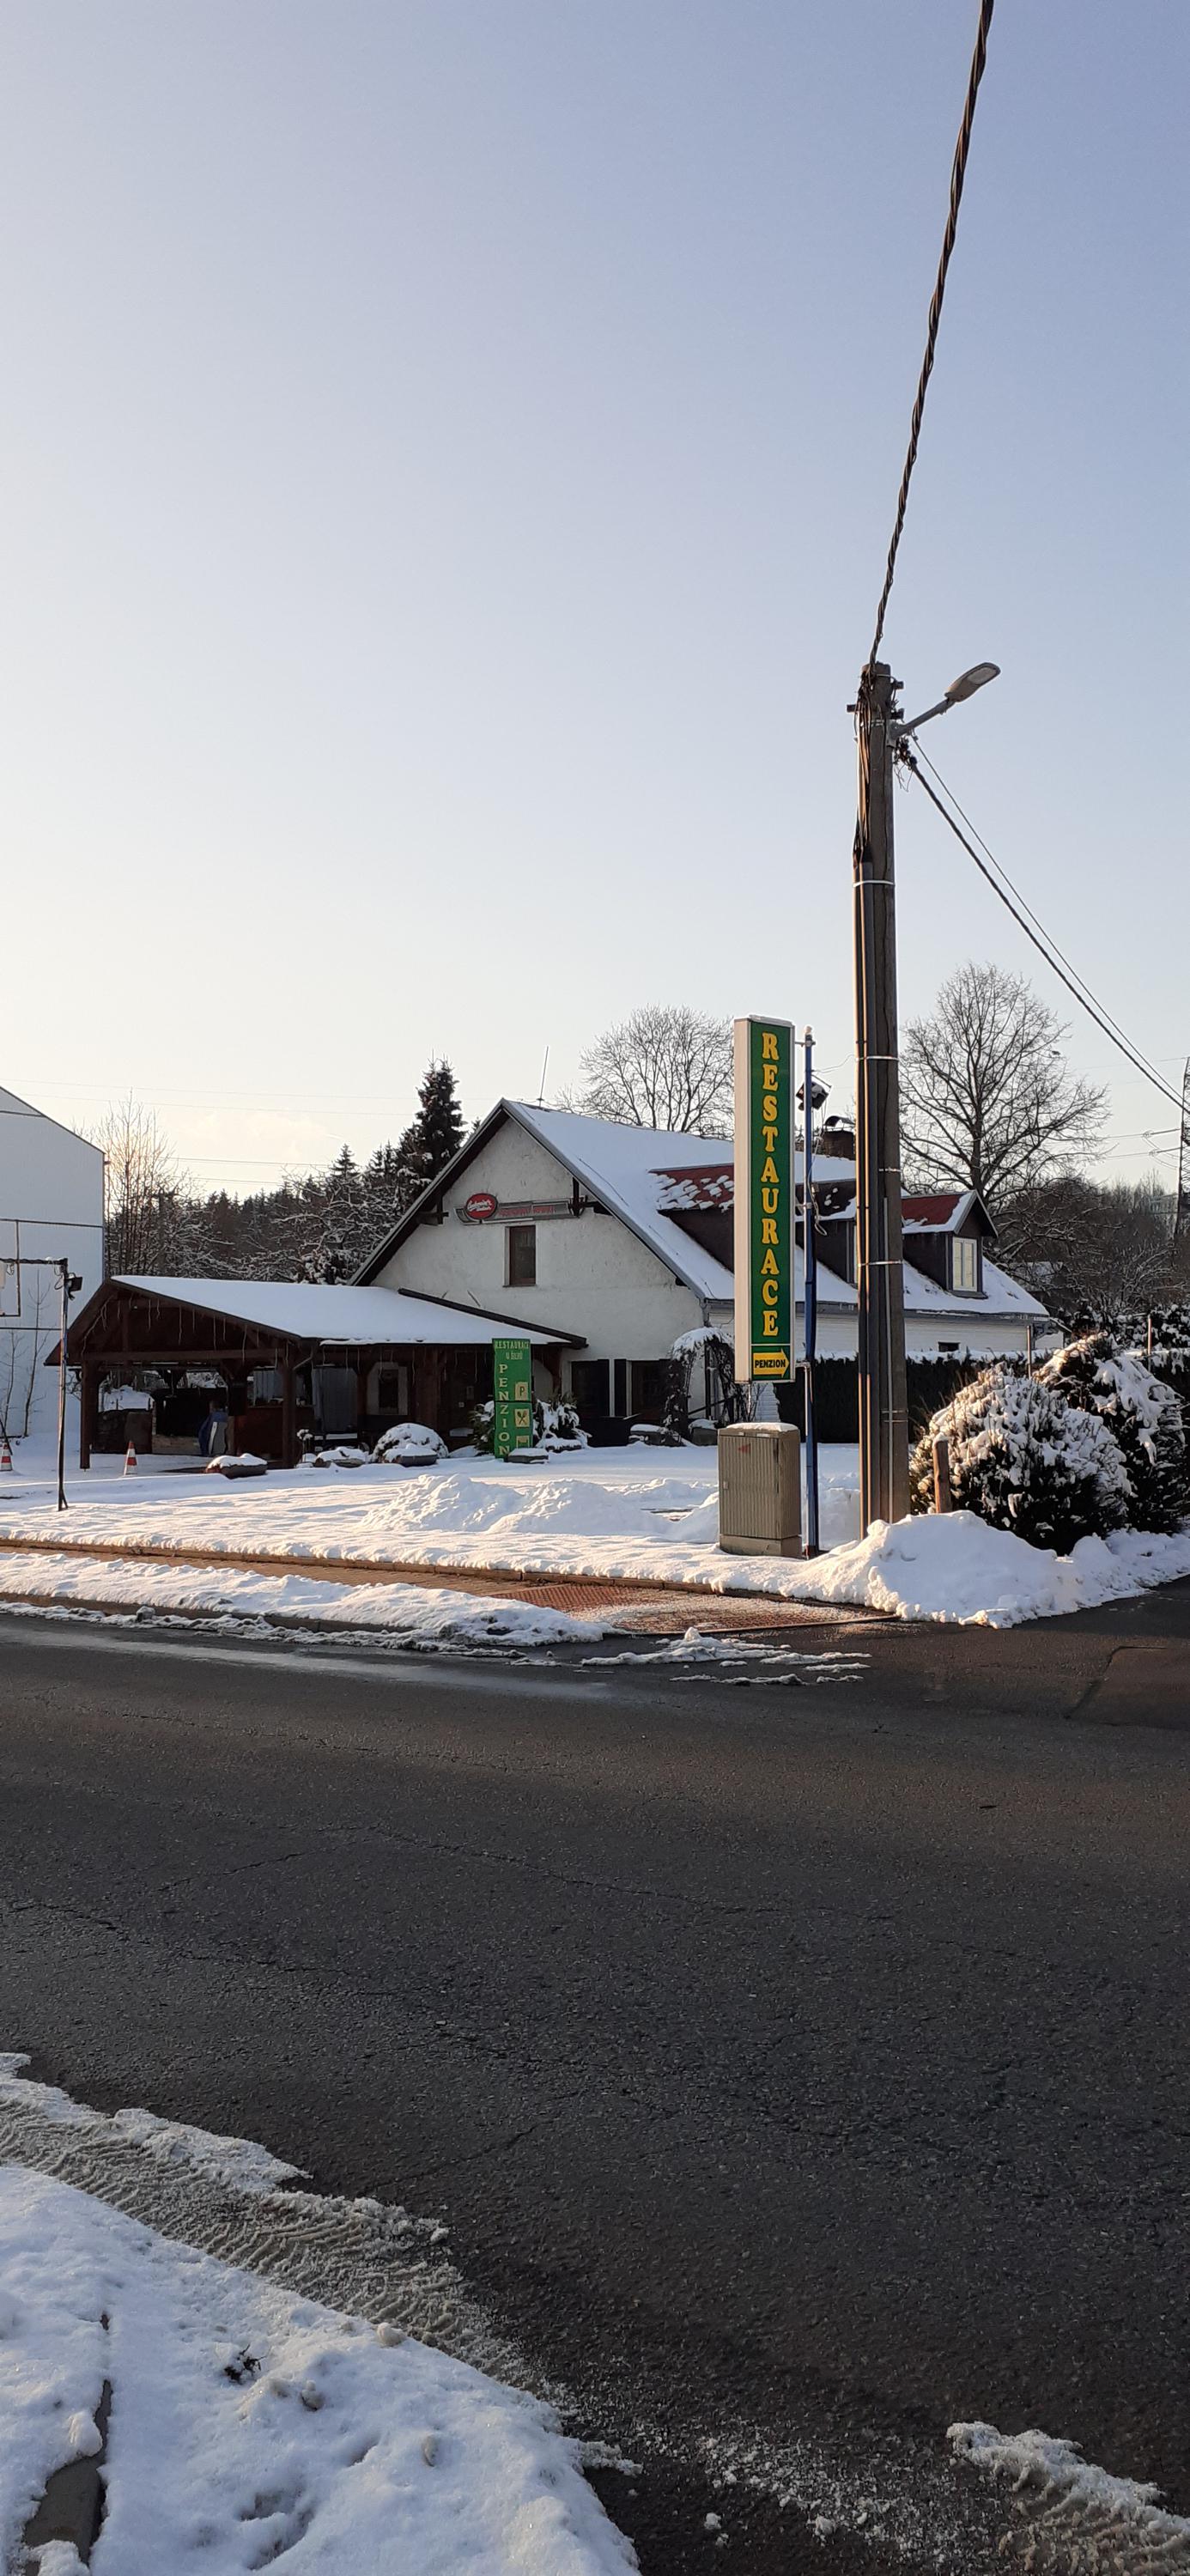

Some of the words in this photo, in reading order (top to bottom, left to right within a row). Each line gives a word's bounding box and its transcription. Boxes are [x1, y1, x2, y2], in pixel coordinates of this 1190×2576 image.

[761, 1032, 780, 1337] RESTAURACE
[755, 1359, 786, 1368] PENZION
[499, 1364, 510, 1455] PENZION
